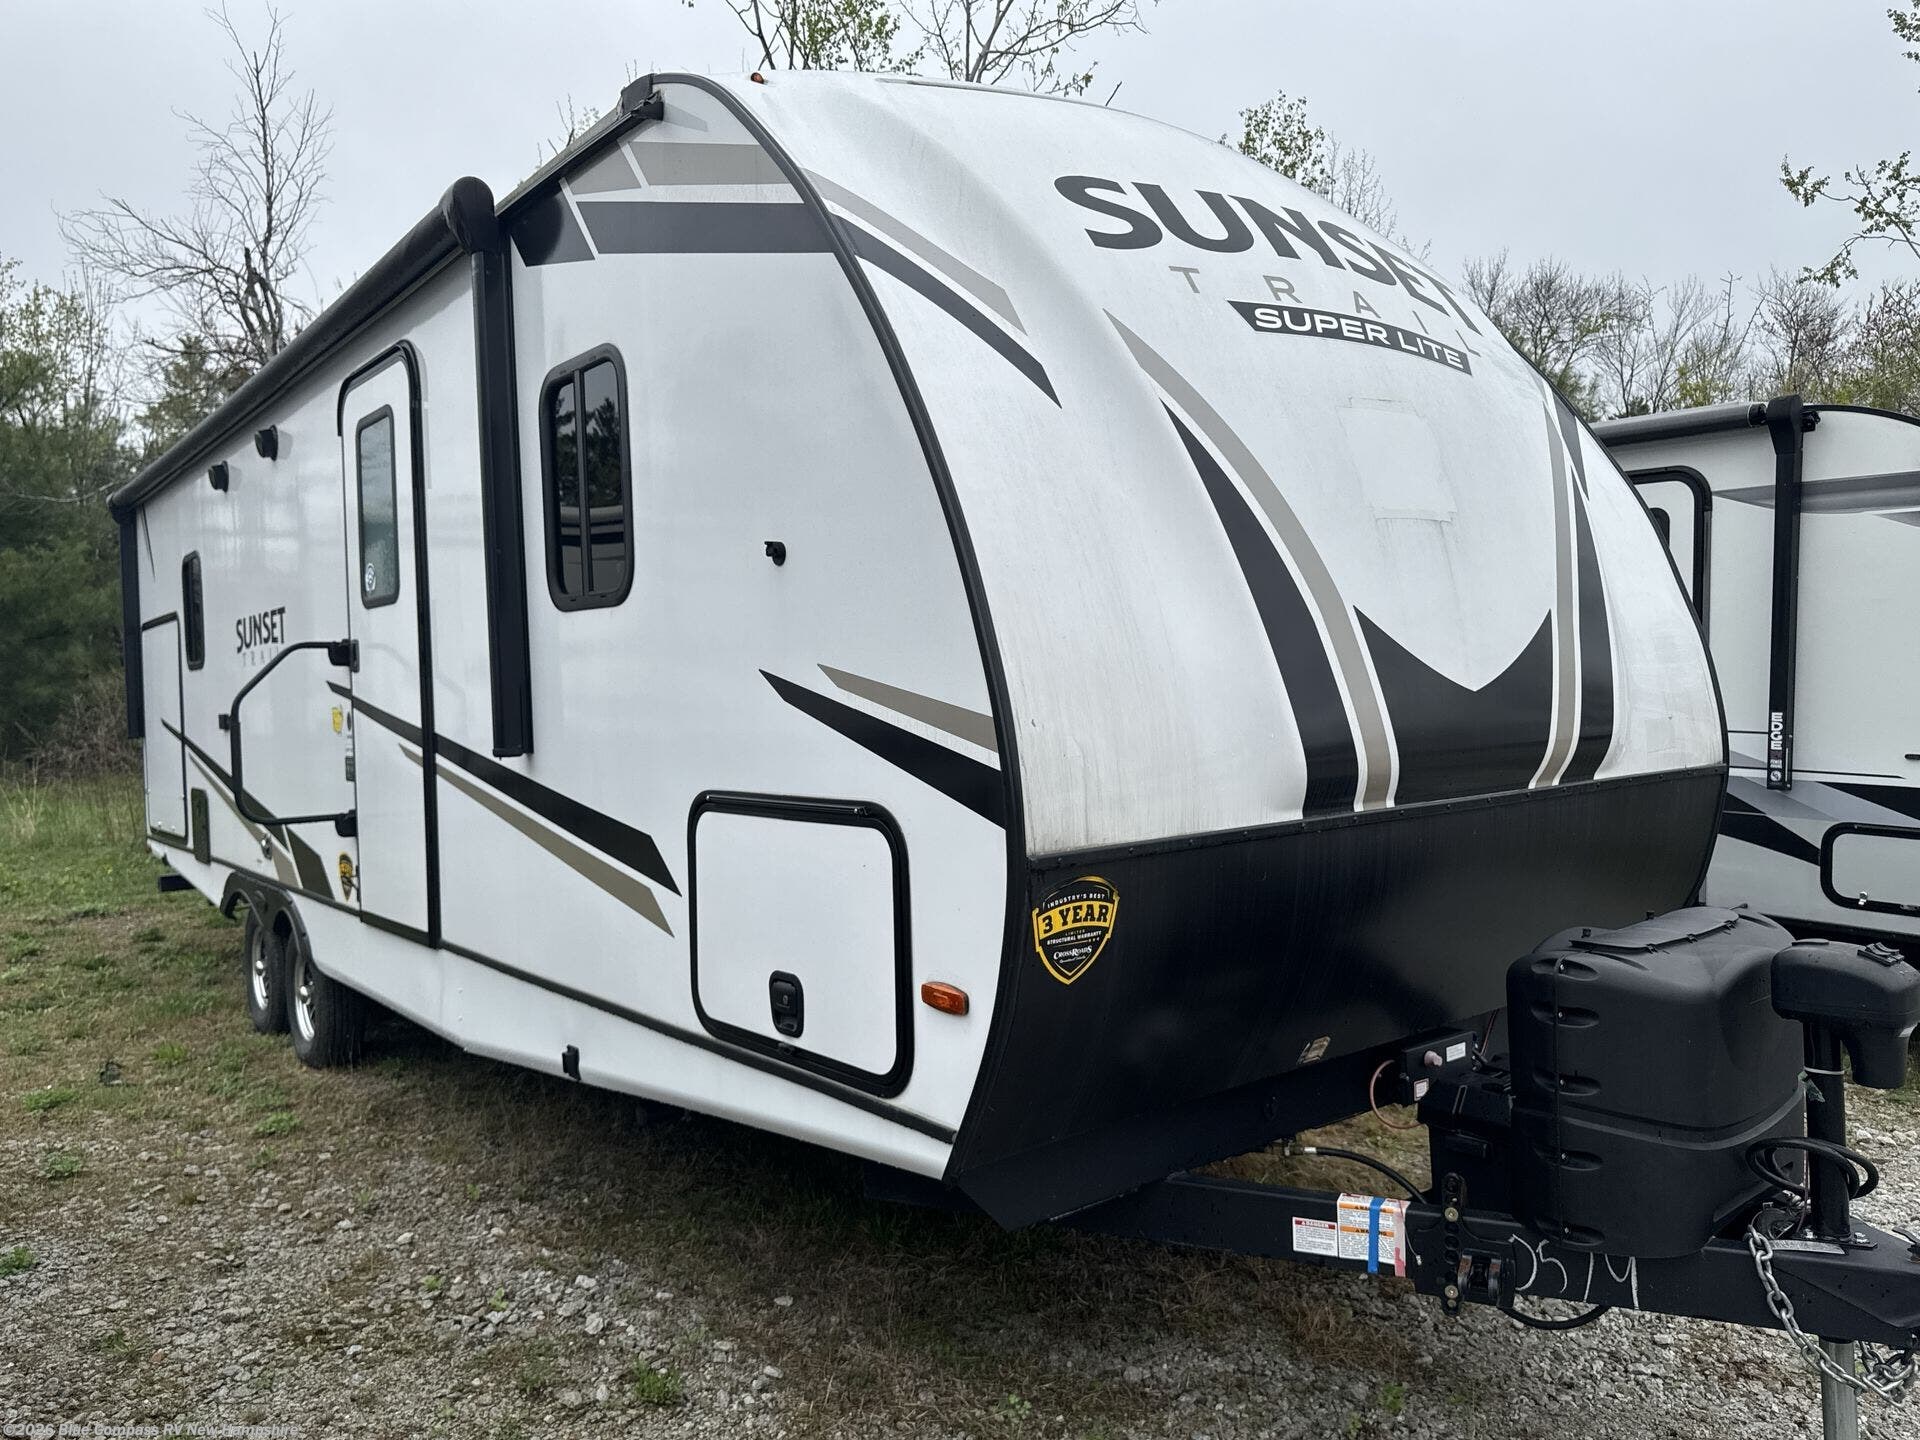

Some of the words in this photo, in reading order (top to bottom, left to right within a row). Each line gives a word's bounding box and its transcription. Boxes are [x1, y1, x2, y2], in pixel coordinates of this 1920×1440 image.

[1053, 175, 1483, 336] SUNSET
[1168, 265, 1482, 357] TRAIL
[1254, 307, 1391, 345] SUPER
[1397, 331, 1466, 369] LITE
[235, 606, 286, 654] SUNSET
[1770, 712, 1784, 750] EDGE
[1043, 915, 1053, 934] 3
[1058, 904, 1109, 926] YEAR
[1047, 894, 1087, 908] INDUSTRY'S
[1047, 935, 1076, 945] STRUCTURAL
[1077, 931, 1101, 939] WARRANTY
